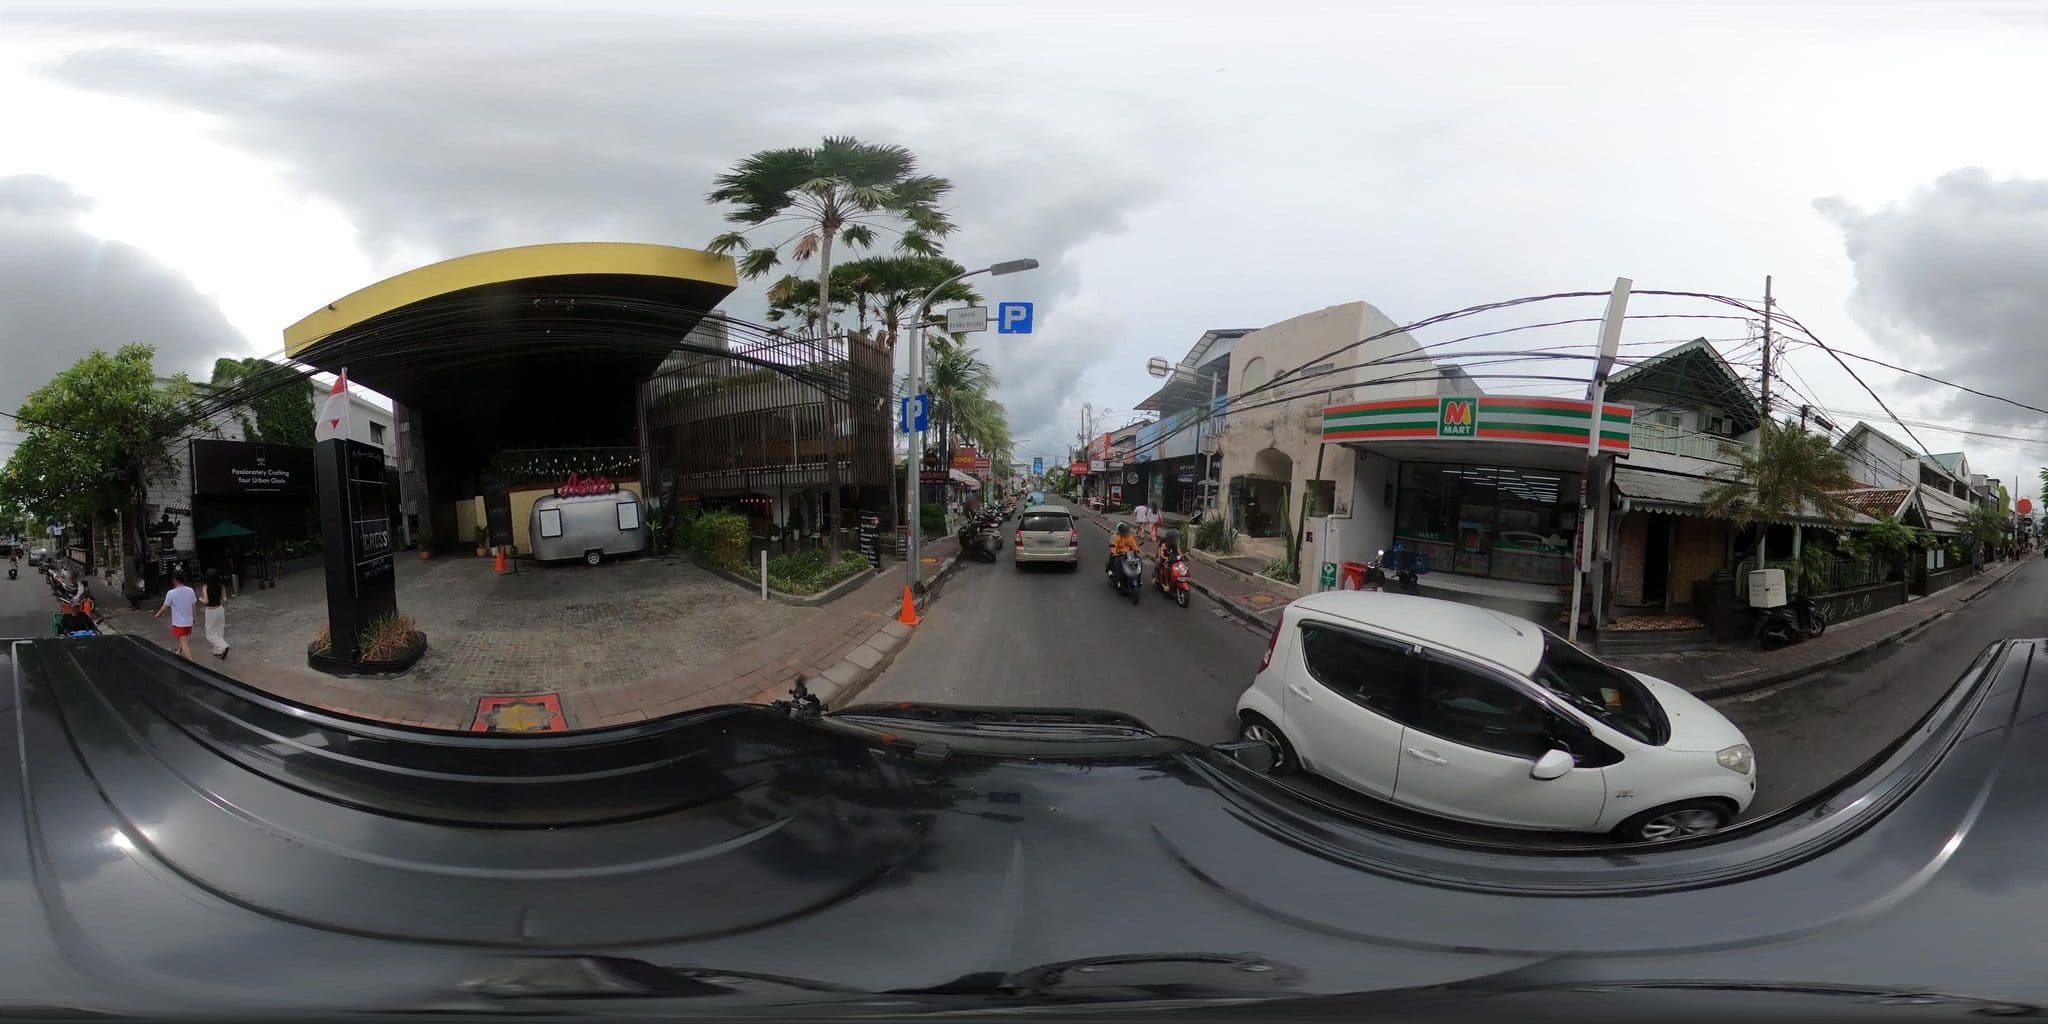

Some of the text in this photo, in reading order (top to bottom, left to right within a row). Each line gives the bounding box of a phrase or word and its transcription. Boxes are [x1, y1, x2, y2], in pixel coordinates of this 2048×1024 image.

[1004, 306, 1026, 330] P
[1443, 425, 1471, 435] MART
[231, 468, 289, 478] Passionately Crafting
